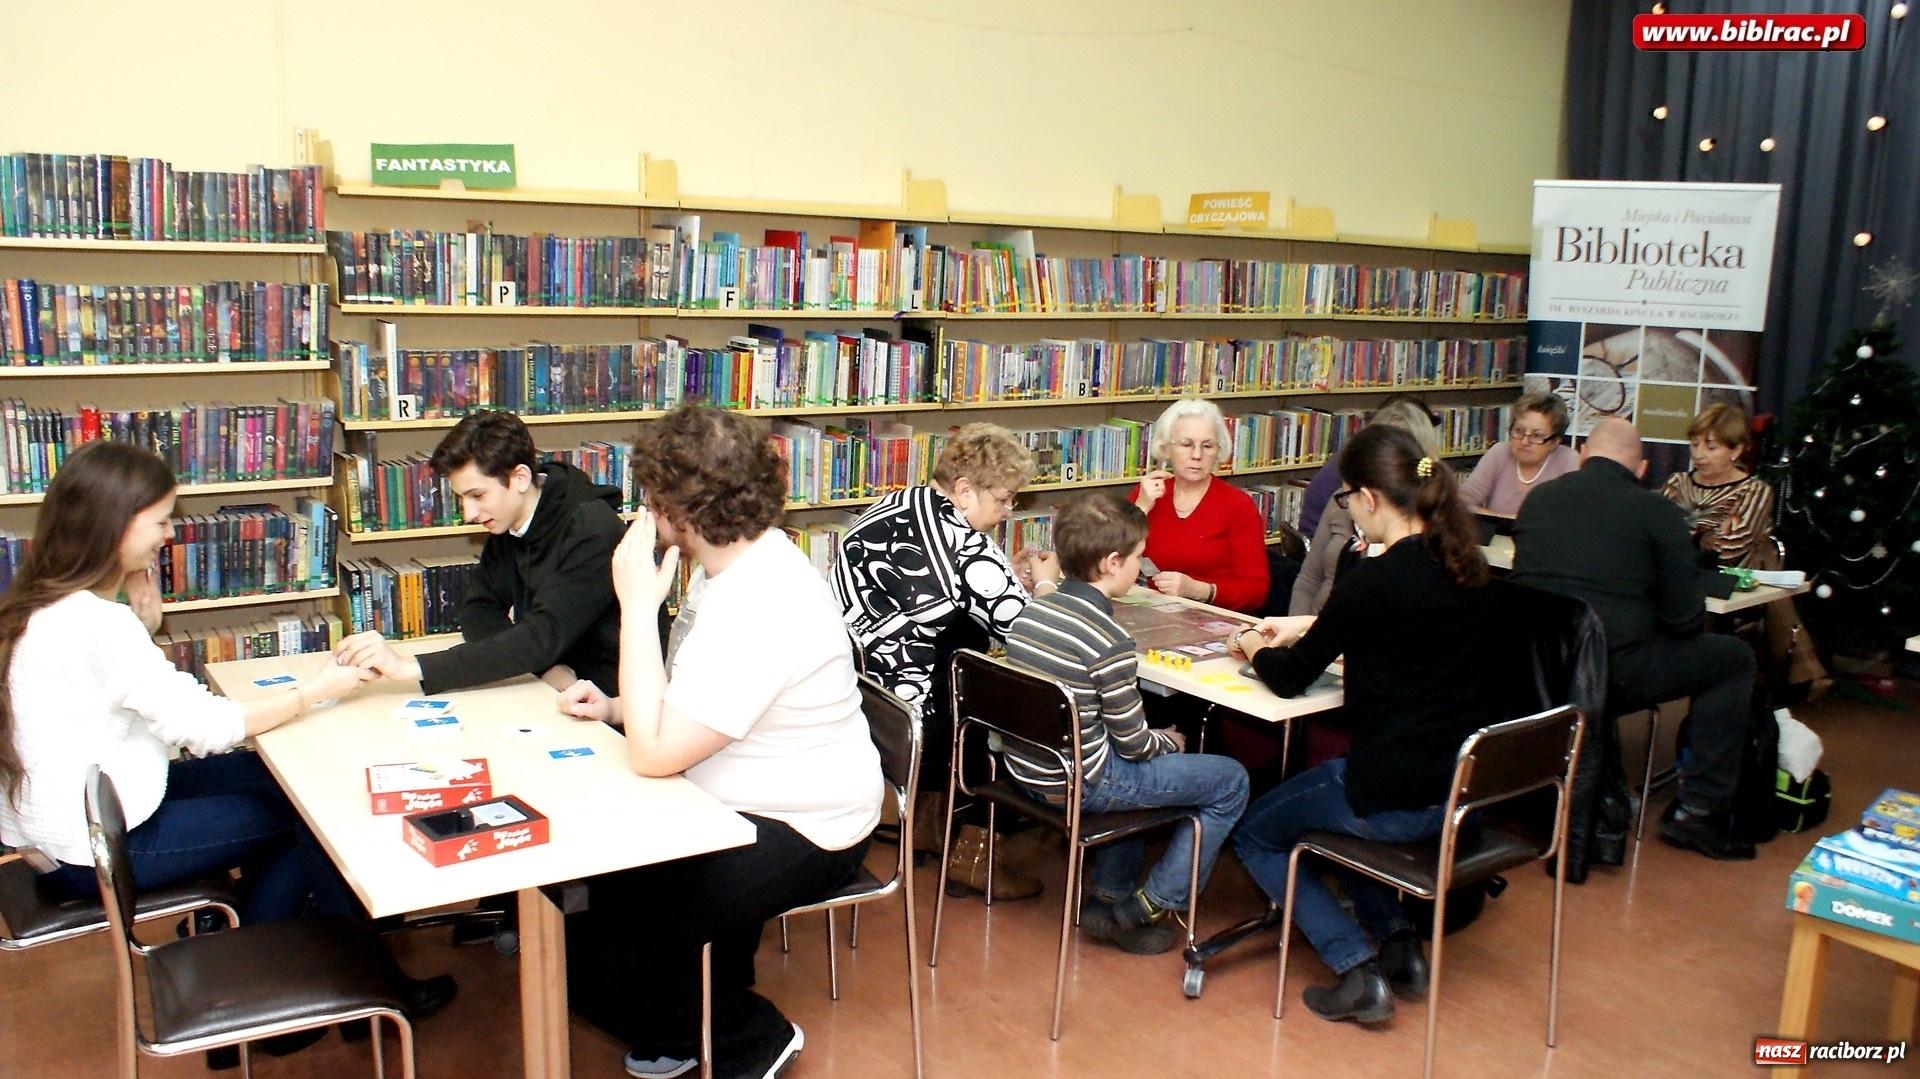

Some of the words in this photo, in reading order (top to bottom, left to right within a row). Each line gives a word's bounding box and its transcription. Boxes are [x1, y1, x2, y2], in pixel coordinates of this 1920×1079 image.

[375, 158, 511, 173] FANTASTYKA
[1203, 197, 1252, 209] POWIEŚĆ
[1189, 211, 1265, 223] OBYCZAJOWA
[1553, 226, 1746, 269] Biblioteka
[1625, 269, 1729, 296] Publiczna
[499, 285, 509, 303] P
[726, 291, 735, 308] F
[911, 294, 918, 310] L
[1078, 383, 1086, 397] B
[399, 399, 410, 417] R
[1066, 466, 1074, 481] C
[1831, 900, 1894, 927] DOMEK
